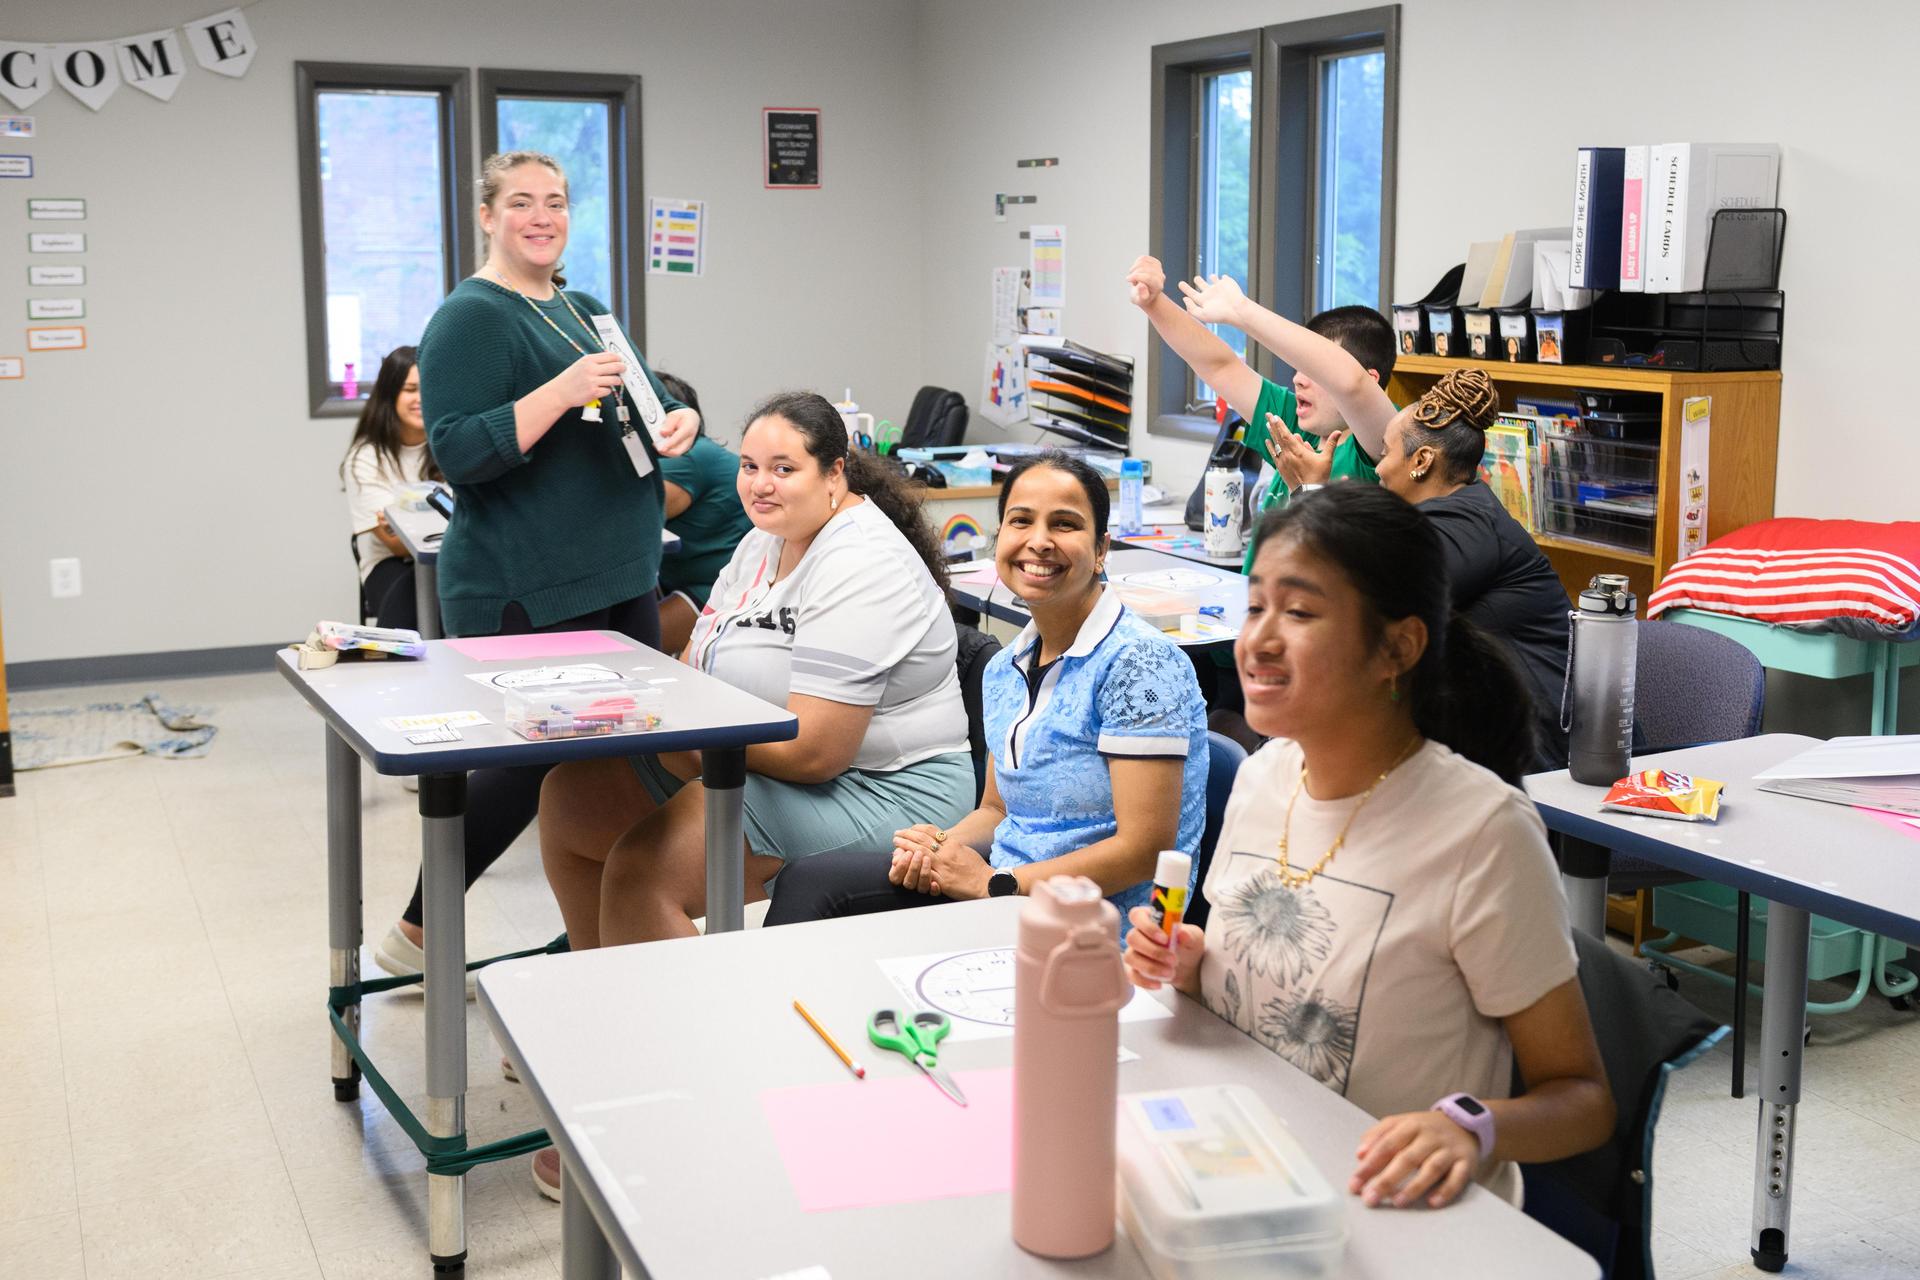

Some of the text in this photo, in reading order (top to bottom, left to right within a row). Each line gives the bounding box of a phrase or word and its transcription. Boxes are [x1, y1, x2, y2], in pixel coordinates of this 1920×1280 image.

[1574, 163, 1588, 274] CHORE OF THE MONTH
[1661, 156, 1679, 258] SCHEDULE CARDS
